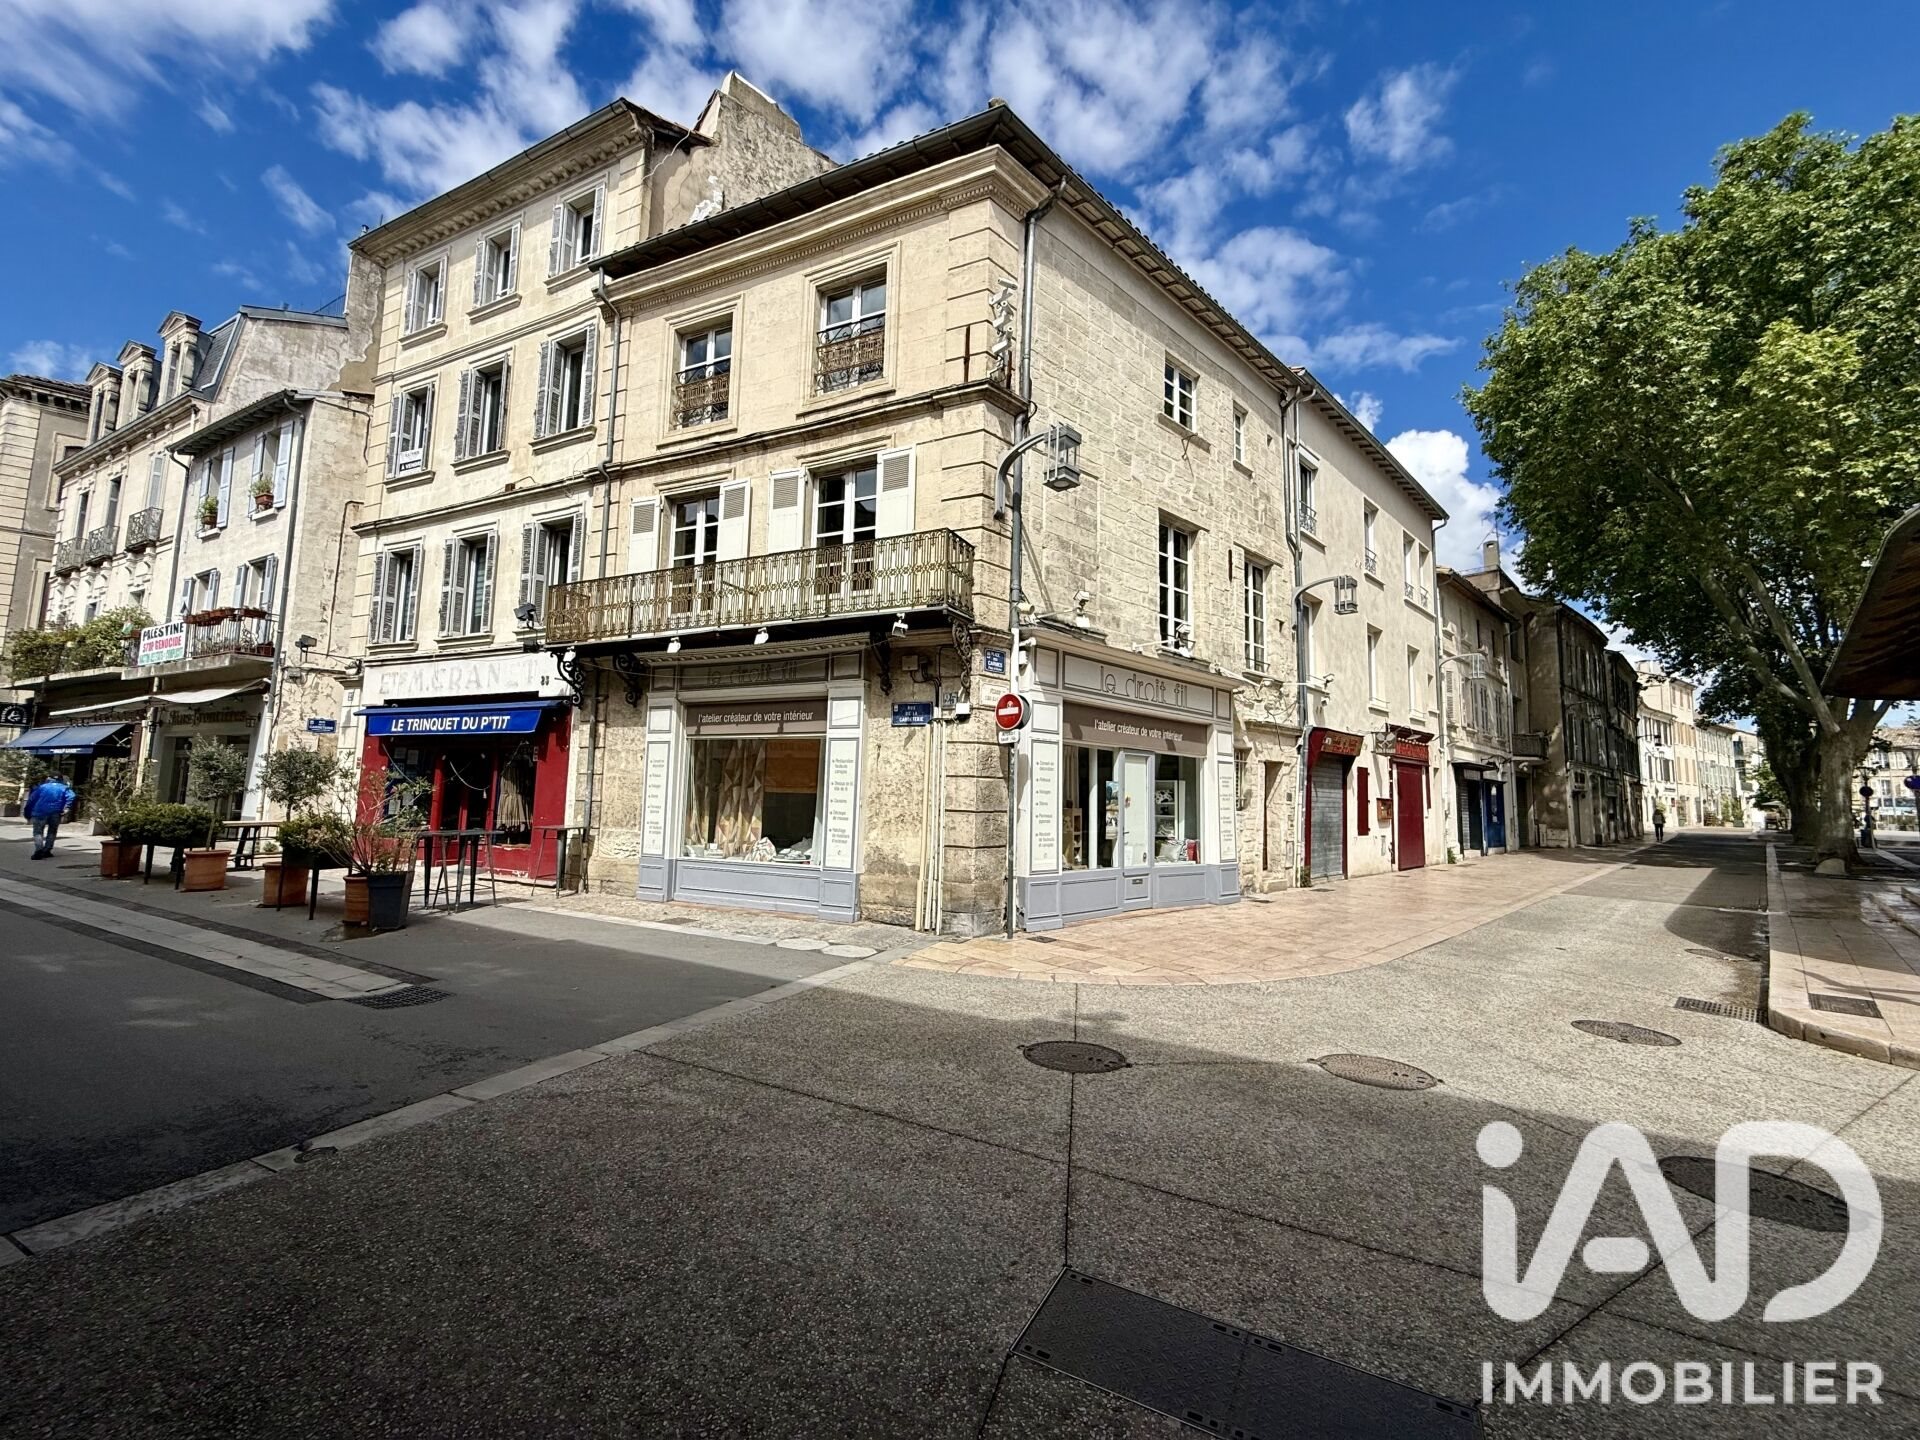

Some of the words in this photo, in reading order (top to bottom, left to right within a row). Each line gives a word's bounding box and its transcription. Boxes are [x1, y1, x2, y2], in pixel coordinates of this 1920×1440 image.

[143, 622, 184, 641] PALESTINE
[155, 636, 182, 650] GENOCIDE
[1101, 666, 1116, 694] le
[1125, 673, 1166, 704] droit
[1174, 683, 1188, 708] fil
[391, 719, 404, 732] LE
[406, 717, 460, 732] TRINQUET
[461, 717, 479, 730] DU
[480, 715, 511, 729] P'TIT
[698, 713, 722, 724] l'atelier
[723, 712, 751, 722] créateur
[753, 712, 762, 721] de
[763, 712, 781, 721] votre
[783, 710, 814, 721] intérieur
[1094, 719, 1116, 732] l'atelier
[1117, 722, 1140, 736] créateur
[1140, 726, 1148, 737] de
[1148, 728, 1161, 739] votre
[1162, 730, 1183, 741] intérieur
